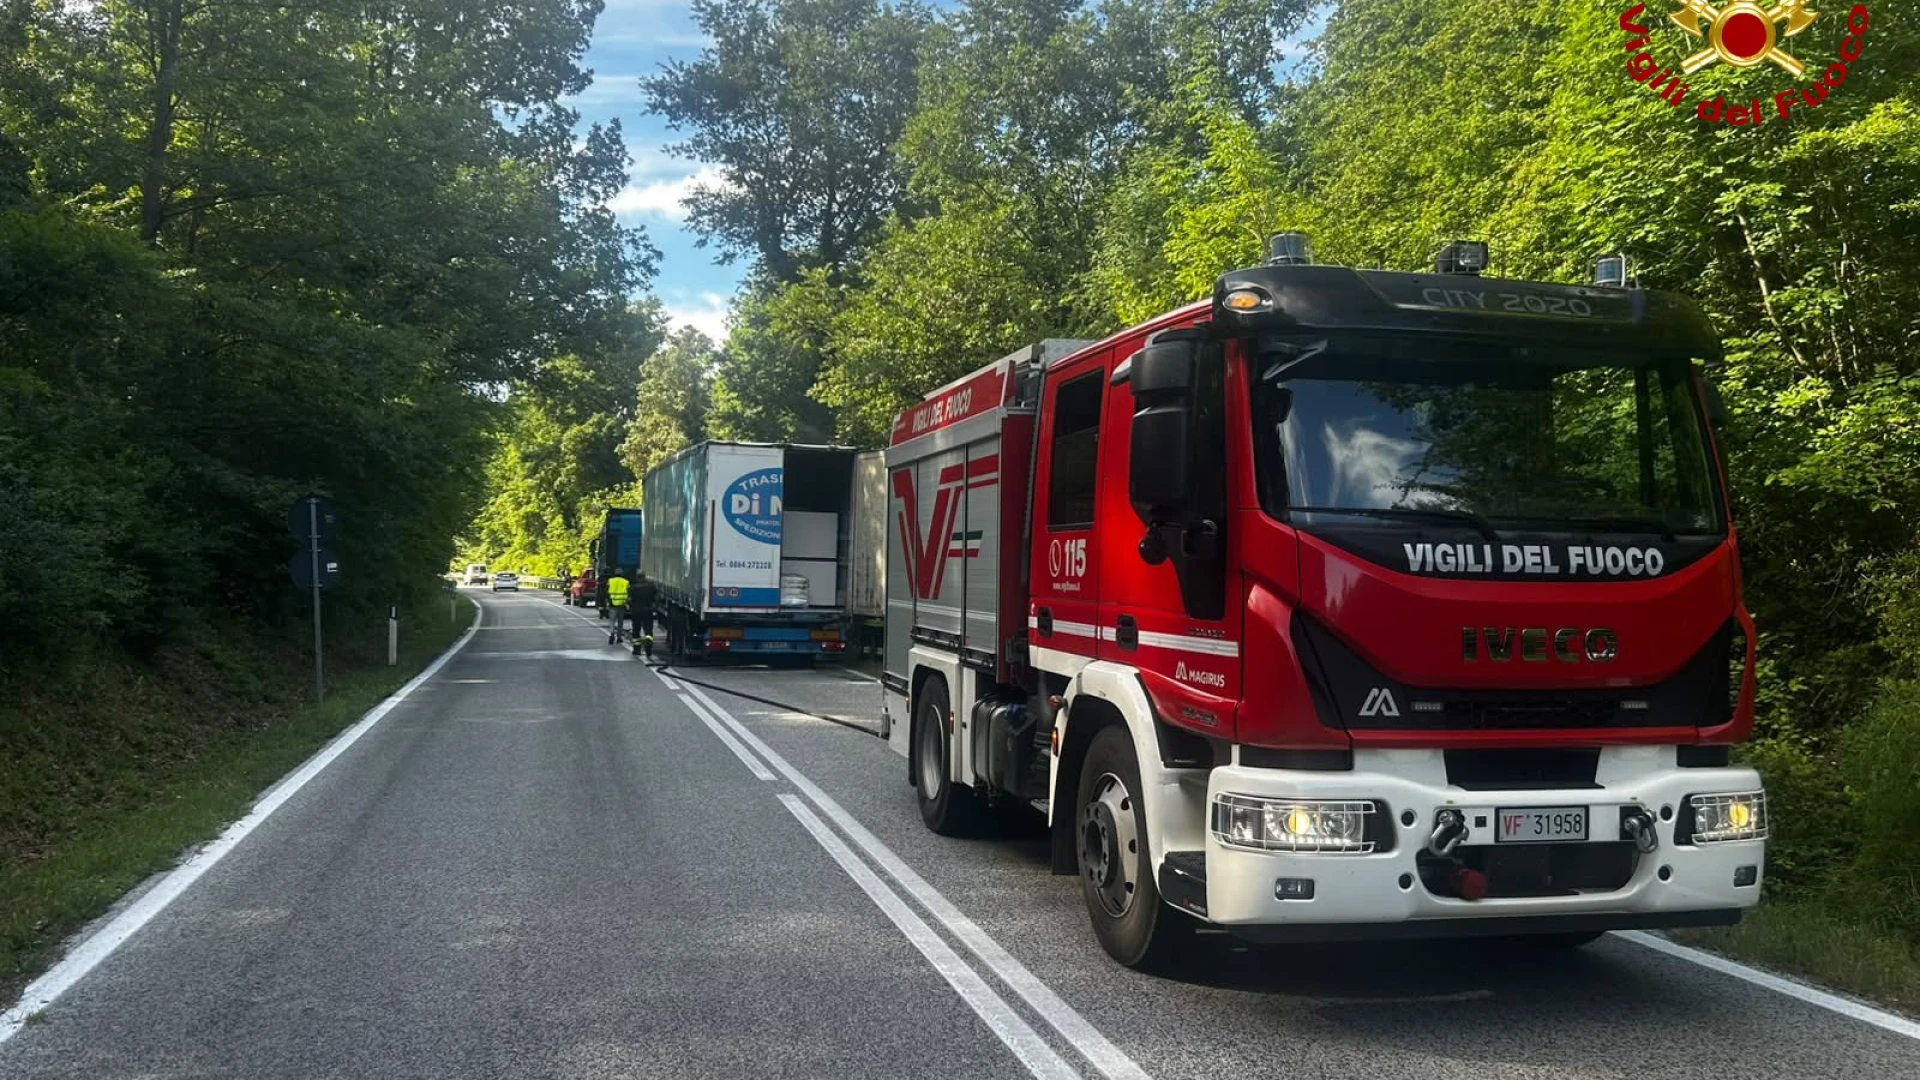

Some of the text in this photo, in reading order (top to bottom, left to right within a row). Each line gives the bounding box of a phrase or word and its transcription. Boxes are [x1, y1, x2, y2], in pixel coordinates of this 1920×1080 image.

[1422, 288, 1591, 317] CITY 2020
[912, 386, 972, 433] VIGILI DEL FUOCO
[731, 492, 760, 515] Di
[1064, 539, 1087, 578] 115
[1403, 543, 1664, 576] VIGILI DEL FUOCO
[1462, 627, 1618, 663] IVECO
[1188, 669, 1226, 688] MAGIRUS
[1504, 813, 1582, 836] VF 31958
